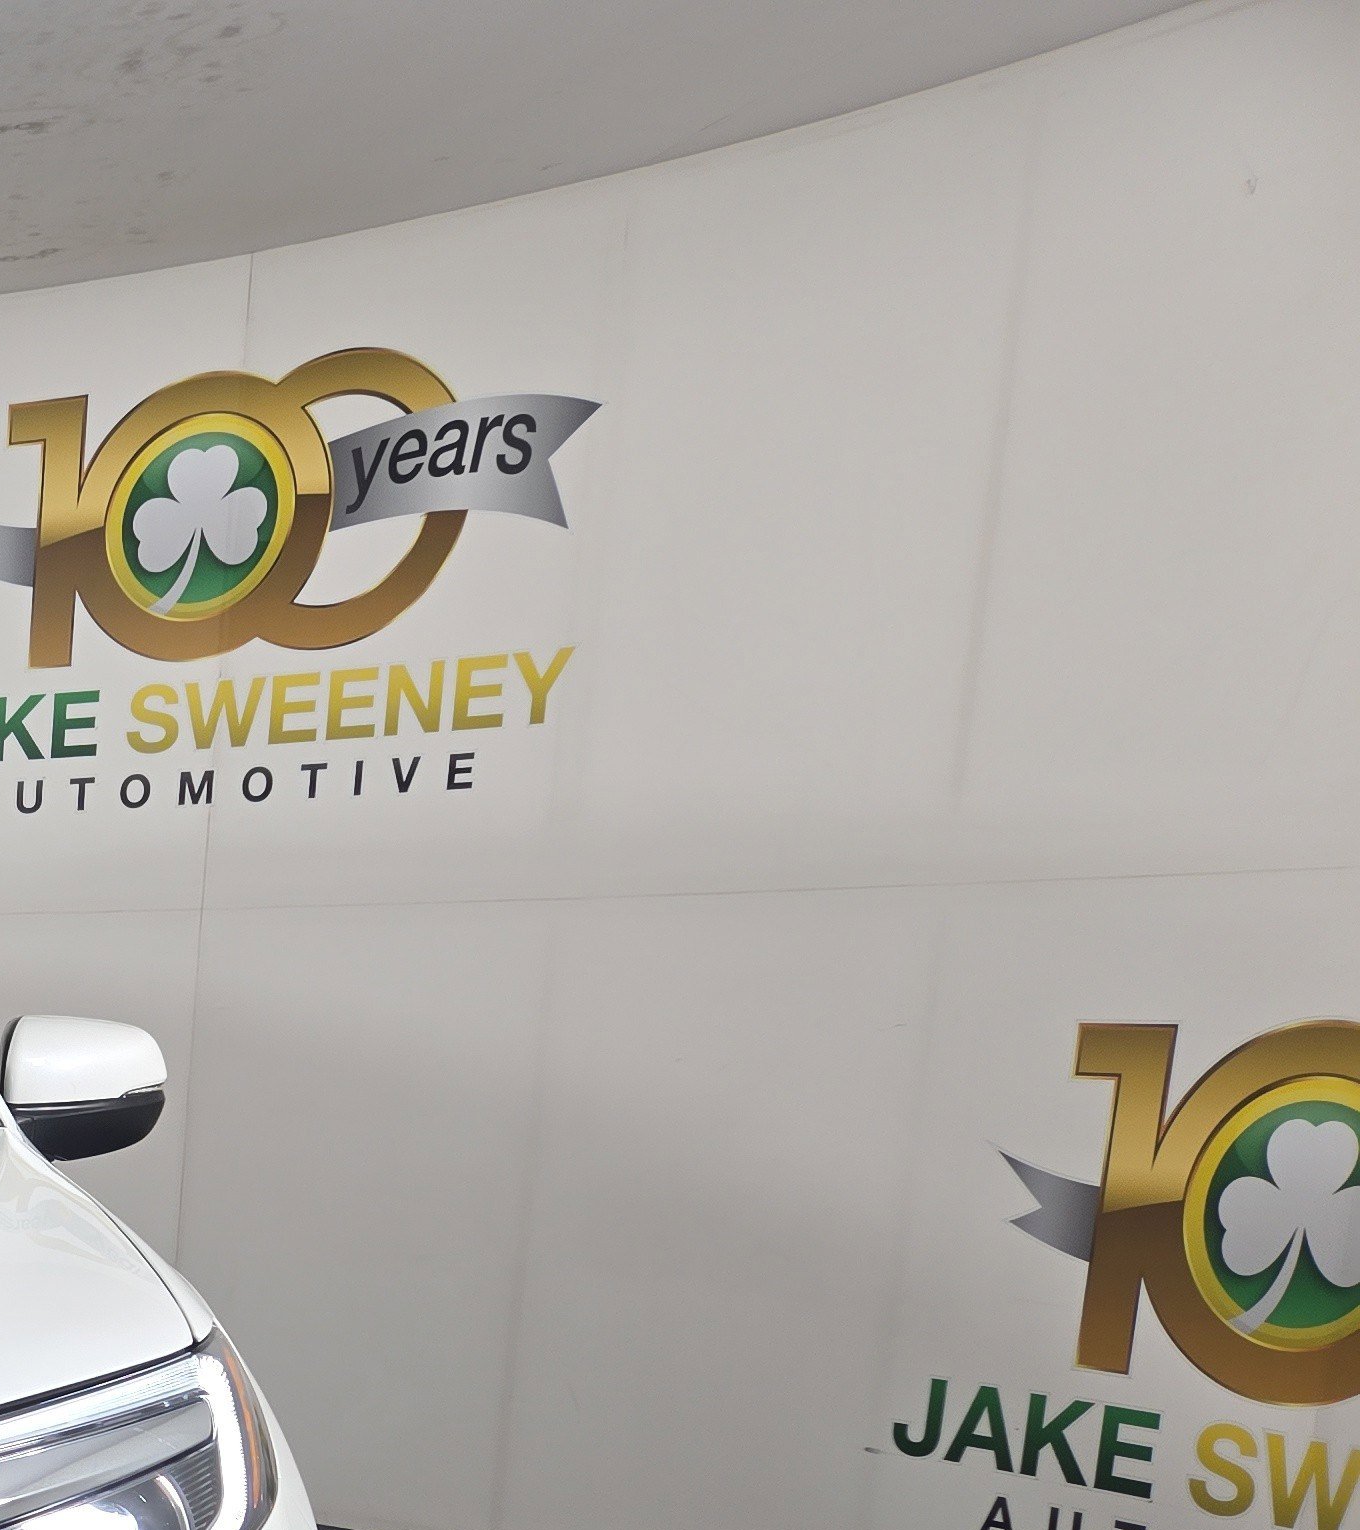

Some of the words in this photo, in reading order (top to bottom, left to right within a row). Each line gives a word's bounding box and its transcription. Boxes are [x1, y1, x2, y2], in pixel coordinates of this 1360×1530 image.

[344, 411, 537, 516] years
[126, 646, 577, 755] SWEENEY
[892, 1378, 1161, 1499] JAKE
